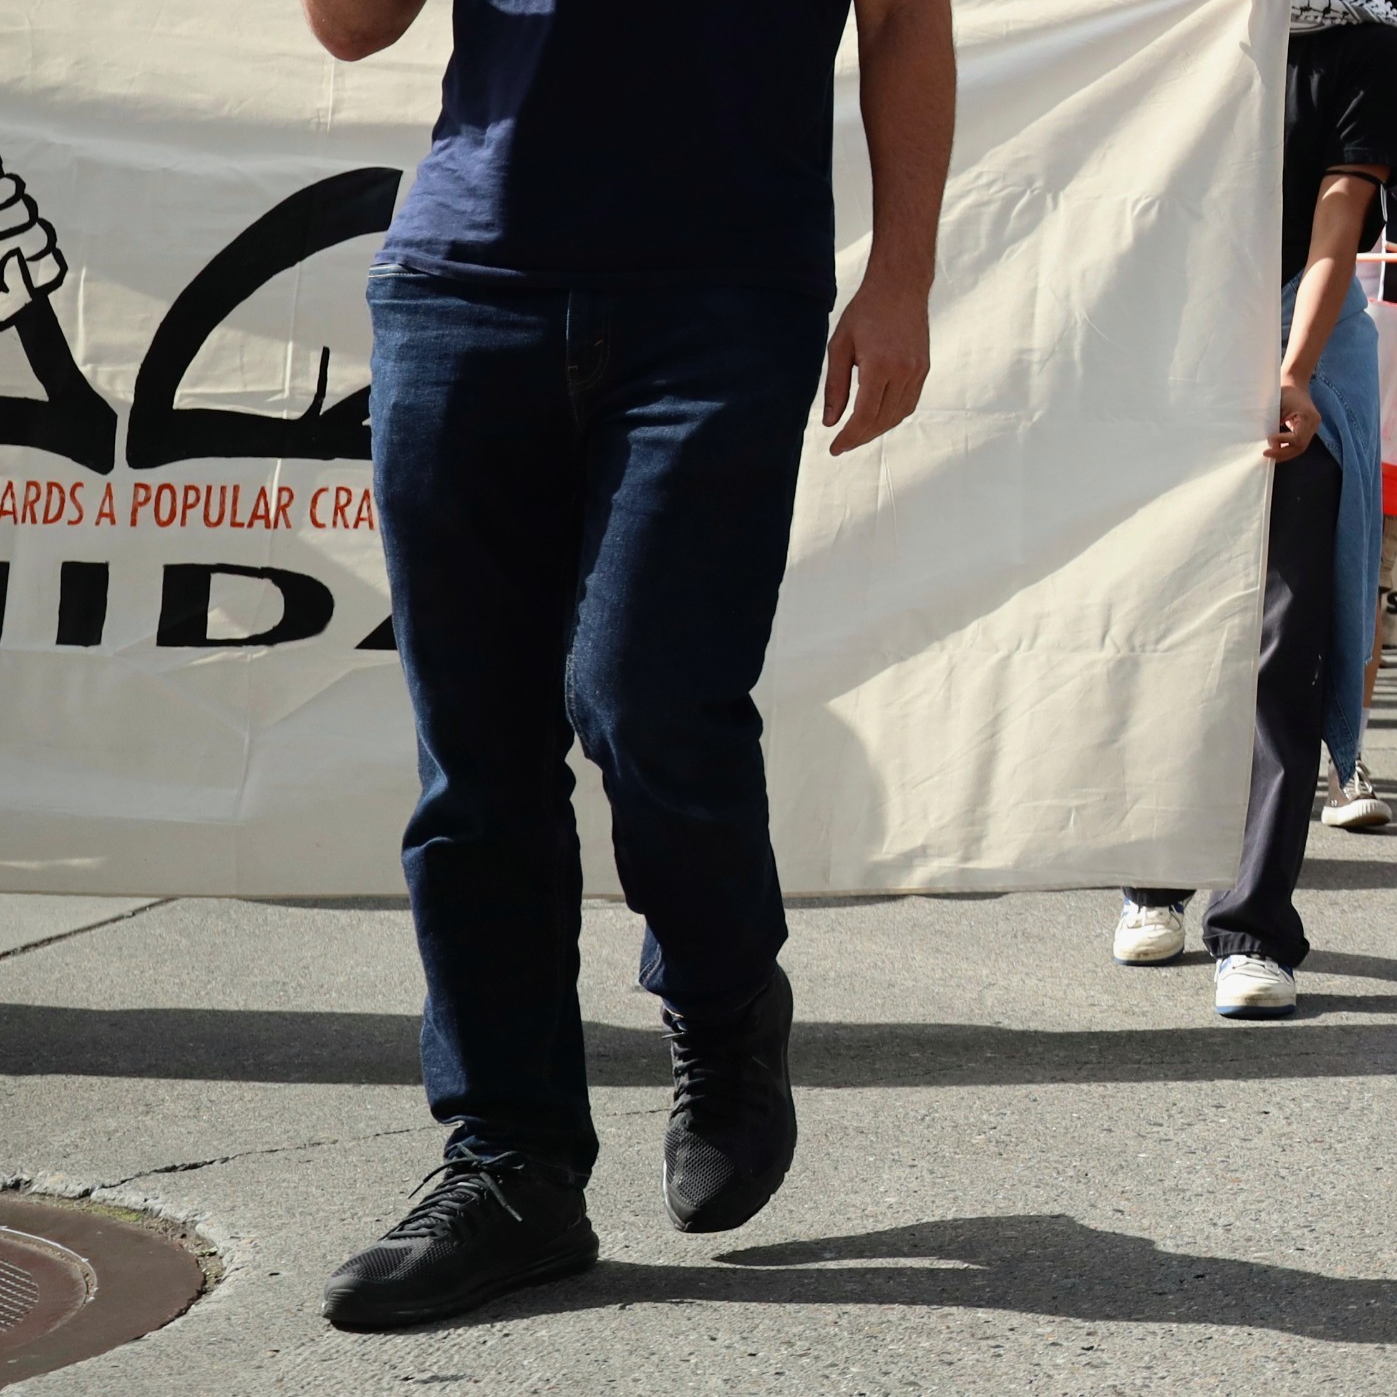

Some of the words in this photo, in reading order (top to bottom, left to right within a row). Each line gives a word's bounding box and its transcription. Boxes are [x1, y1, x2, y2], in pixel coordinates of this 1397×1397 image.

[95, 482, 117, 527] A
[129, 482, 295, 530] POPULAR
[309, 486, 376, 531] CRA
